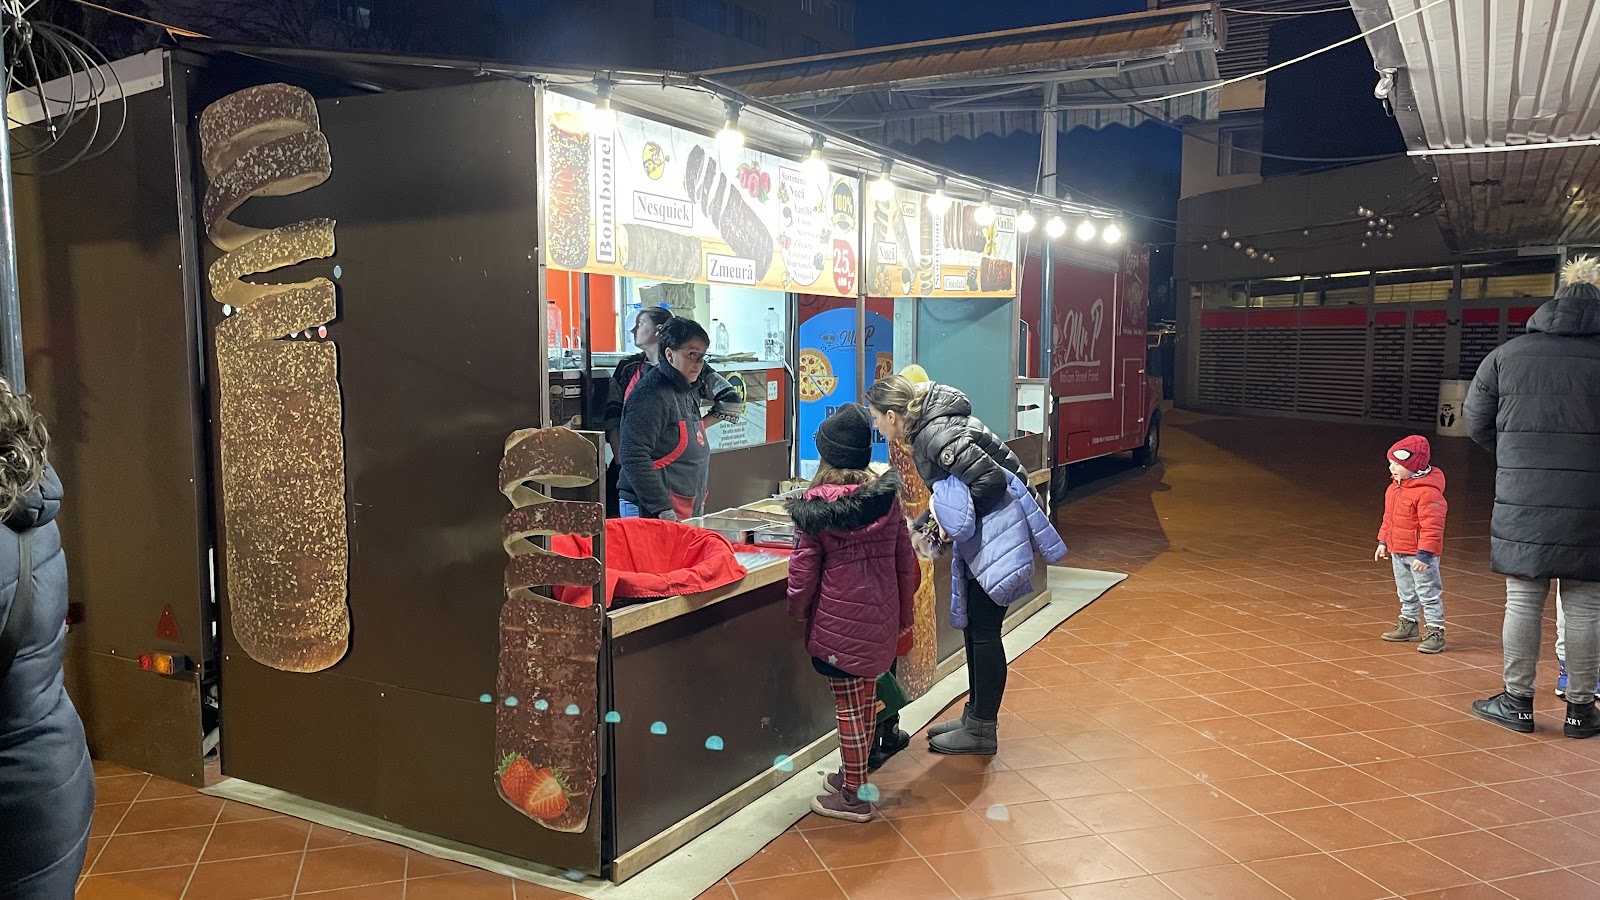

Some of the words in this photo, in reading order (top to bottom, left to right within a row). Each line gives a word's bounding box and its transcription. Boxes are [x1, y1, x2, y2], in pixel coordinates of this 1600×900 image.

[599, 136, 612, 258] Bombonel
[637, 195, 690, 222] Nesquick
[834, 193, 853, 214] 100%
[710, 258, 754, 281] Zmeură
[833, 248, 849, 274] 25
[1060, 369, 1075, 383] Italian
[1075, 369, 1088, 382] Street
[1088, 368, 1099, 382] Food
[1565, 717, 1583, 726] XRY
